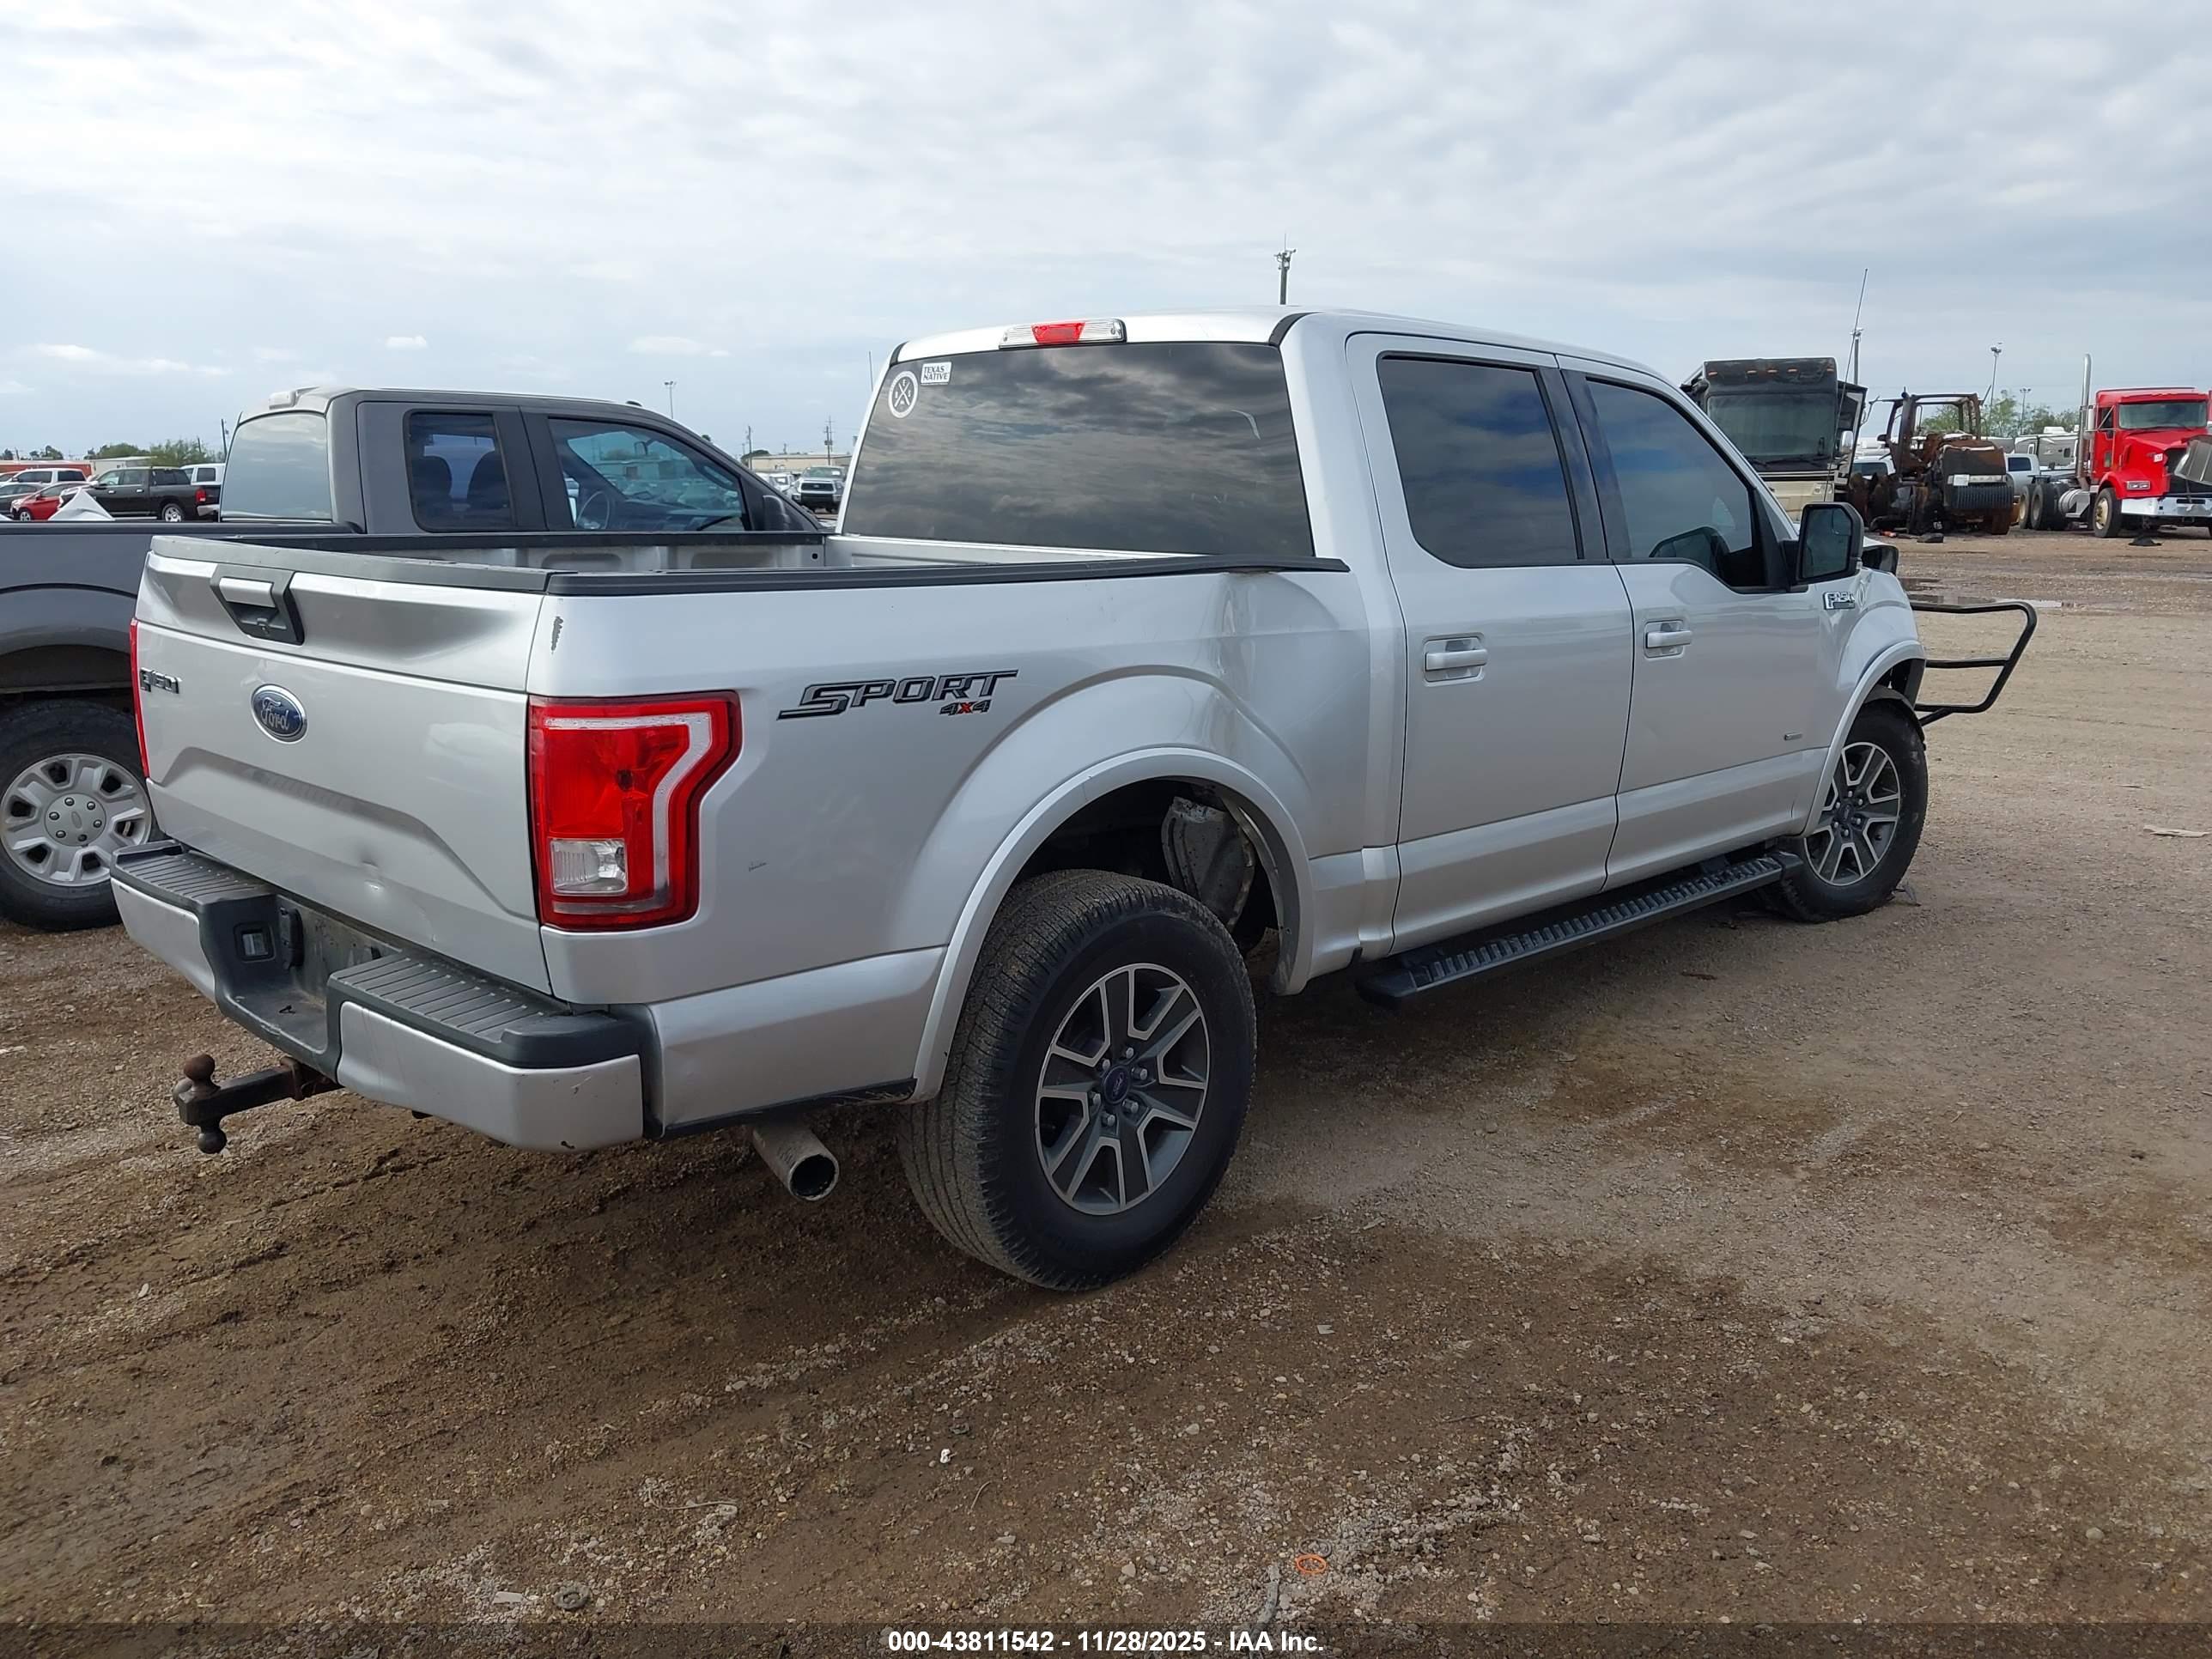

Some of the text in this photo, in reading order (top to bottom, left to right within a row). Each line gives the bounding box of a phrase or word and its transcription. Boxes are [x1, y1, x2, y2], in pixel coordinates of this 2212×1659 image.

[923, 372, 949, 380] NATIVE
[776, 669, 1019, 721] SPORT
[260, 696, 289, 731] Ford
